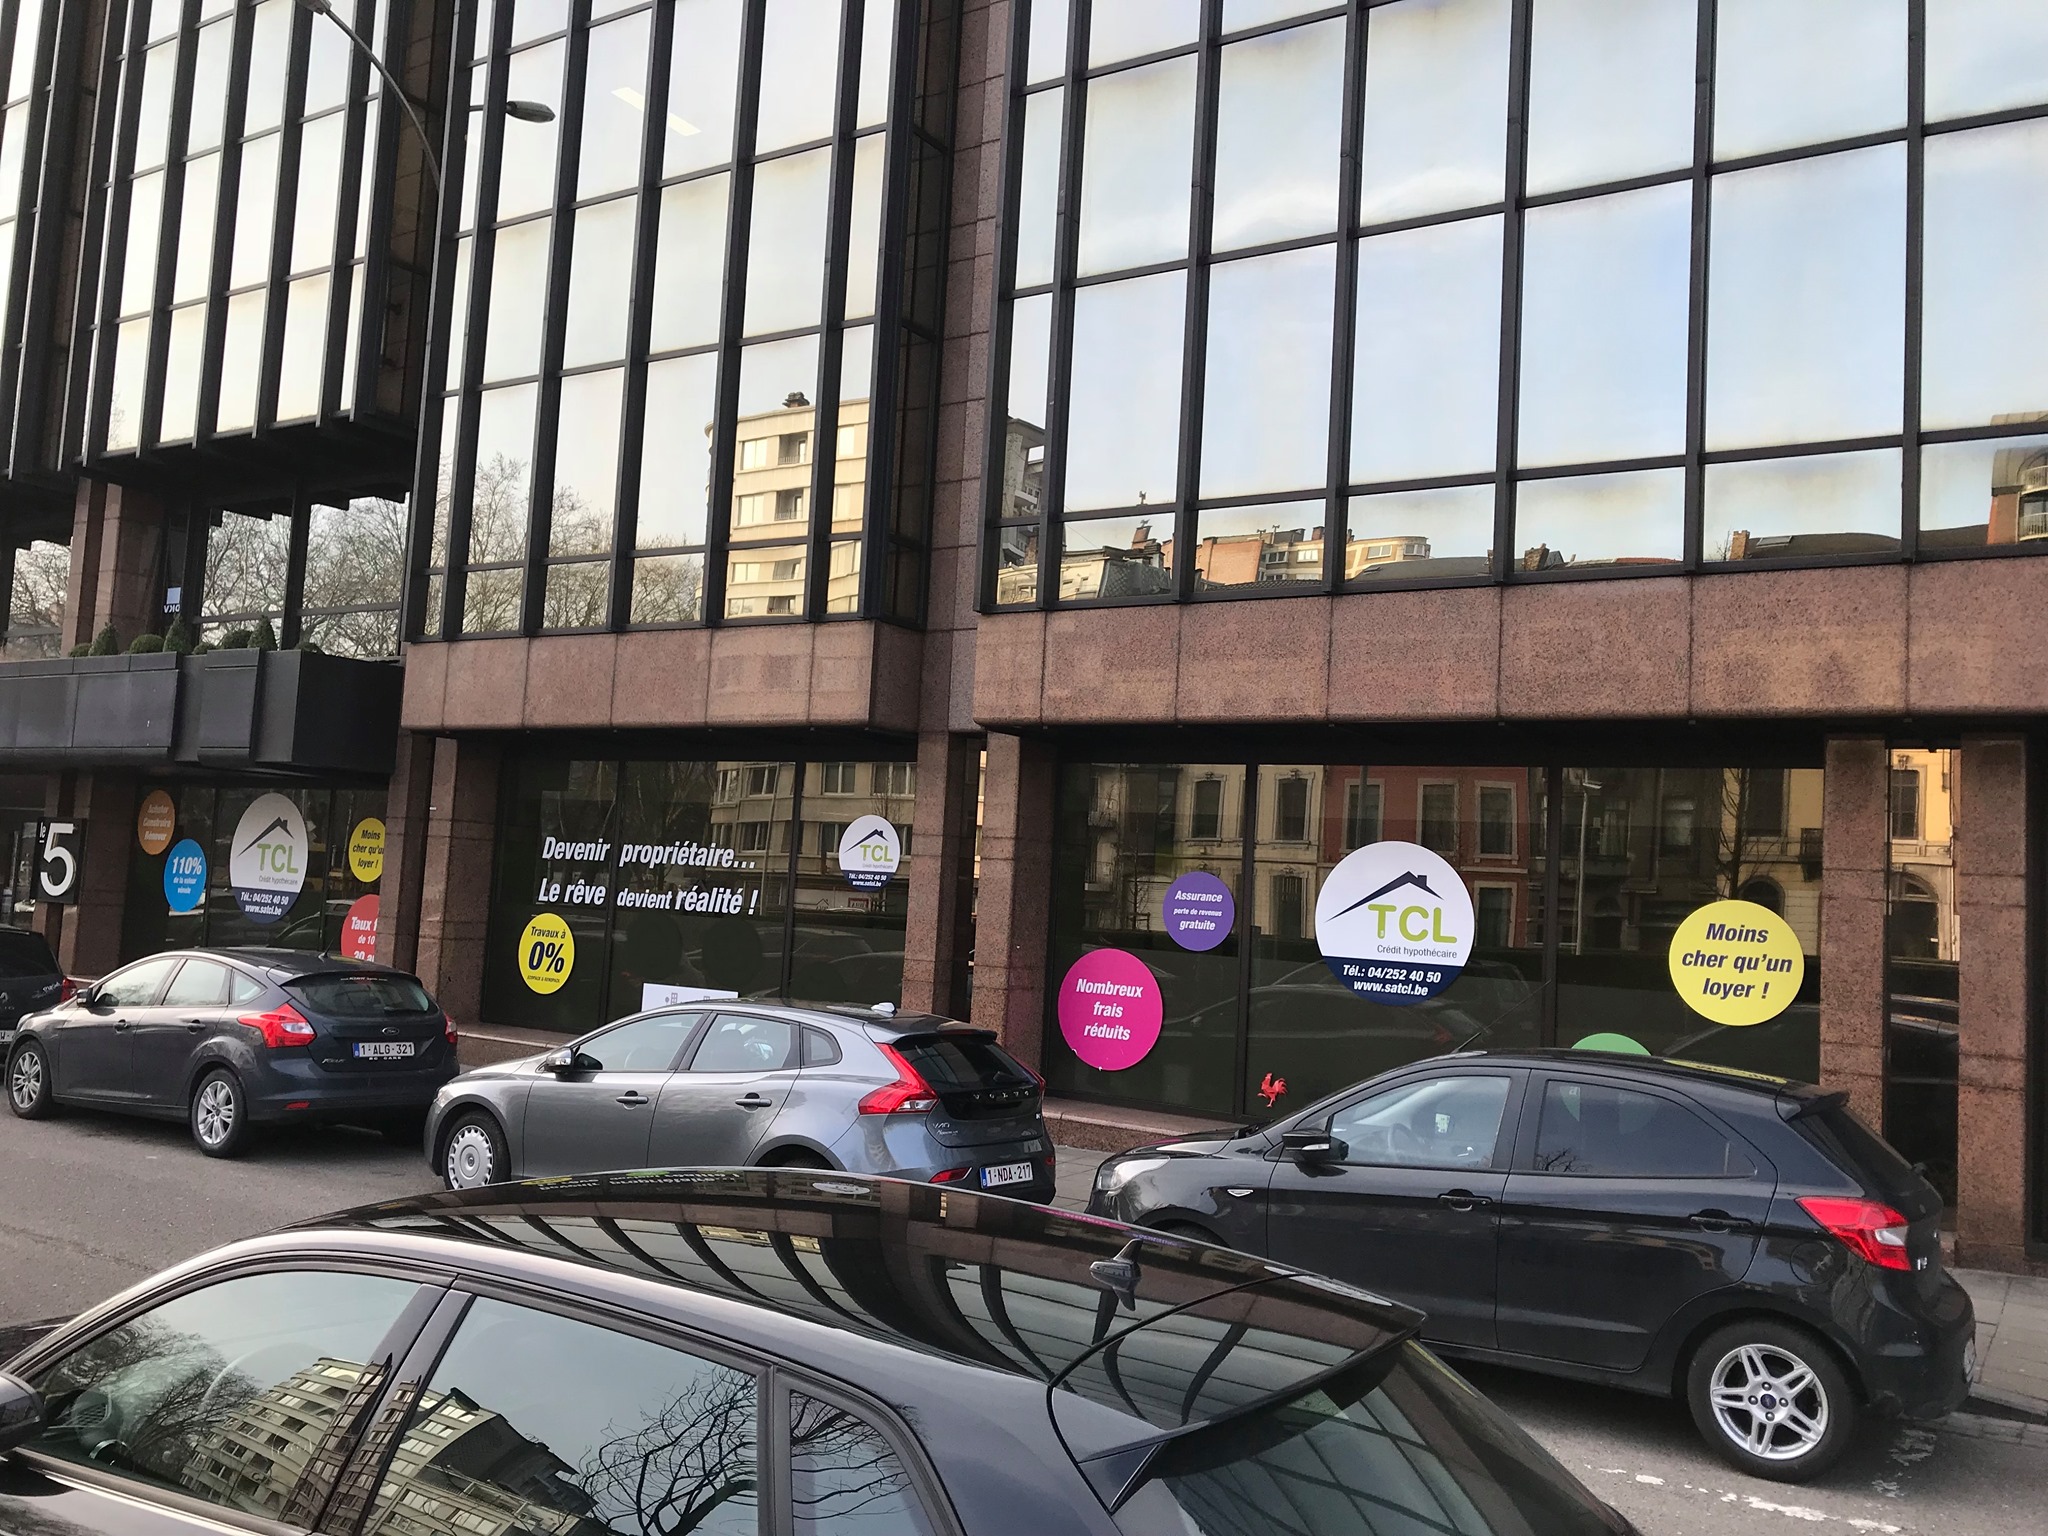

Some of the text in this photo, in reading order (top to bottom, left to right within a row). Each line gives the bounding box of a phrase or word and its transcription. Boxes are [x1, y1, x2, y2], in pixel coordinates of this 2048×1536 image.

[361, 830, 381, 840] Moins
[353, 844, 367, 853] cher
[542, 836, 756, 869] Devenir propriétaire...
[860, 844, 894, 862] TCL
[39, 822, 74, 897] le 5
[172, 856, 202, 875] 110%
[257, 844, 298, 874] TCL
[358, 858, 374, 869] loyer
[252, 893, 272, 903] 04/252
[273, 895, 281, 904] 40
[281, 896, 289, 905] 50
[539, 878, 759, 915] Le rêve devient réalité !
[1175, 890, 1223, 902] Assurance
[351, 917, 372, 931] Taux
[531, 926, 566, 939] Travaux à
[1179, 920, 1216, 930] gratuite
[1368, 904, 1457, 943] TCL
[358, 934, 366, 944] de
[1706, 923, 1769, 943] Moins
[529, 941, 565, 973] 0%
[1377, 945, 1457, 958] Crédit hypothécaire
[1682, 950, 1728, 968] cher
[1343, 965, 1441, 983] Tél.: 04/252 40 50
[1076, 978, 1143, 998] Nombreux
[1354, 981, 1428, 996] www.satcl.be
[1702, 978, 1769, 1000] loyer !
[1093, 1002, 1123, 1017] frais
[1084, 1022, 1130, 1040] réduits
